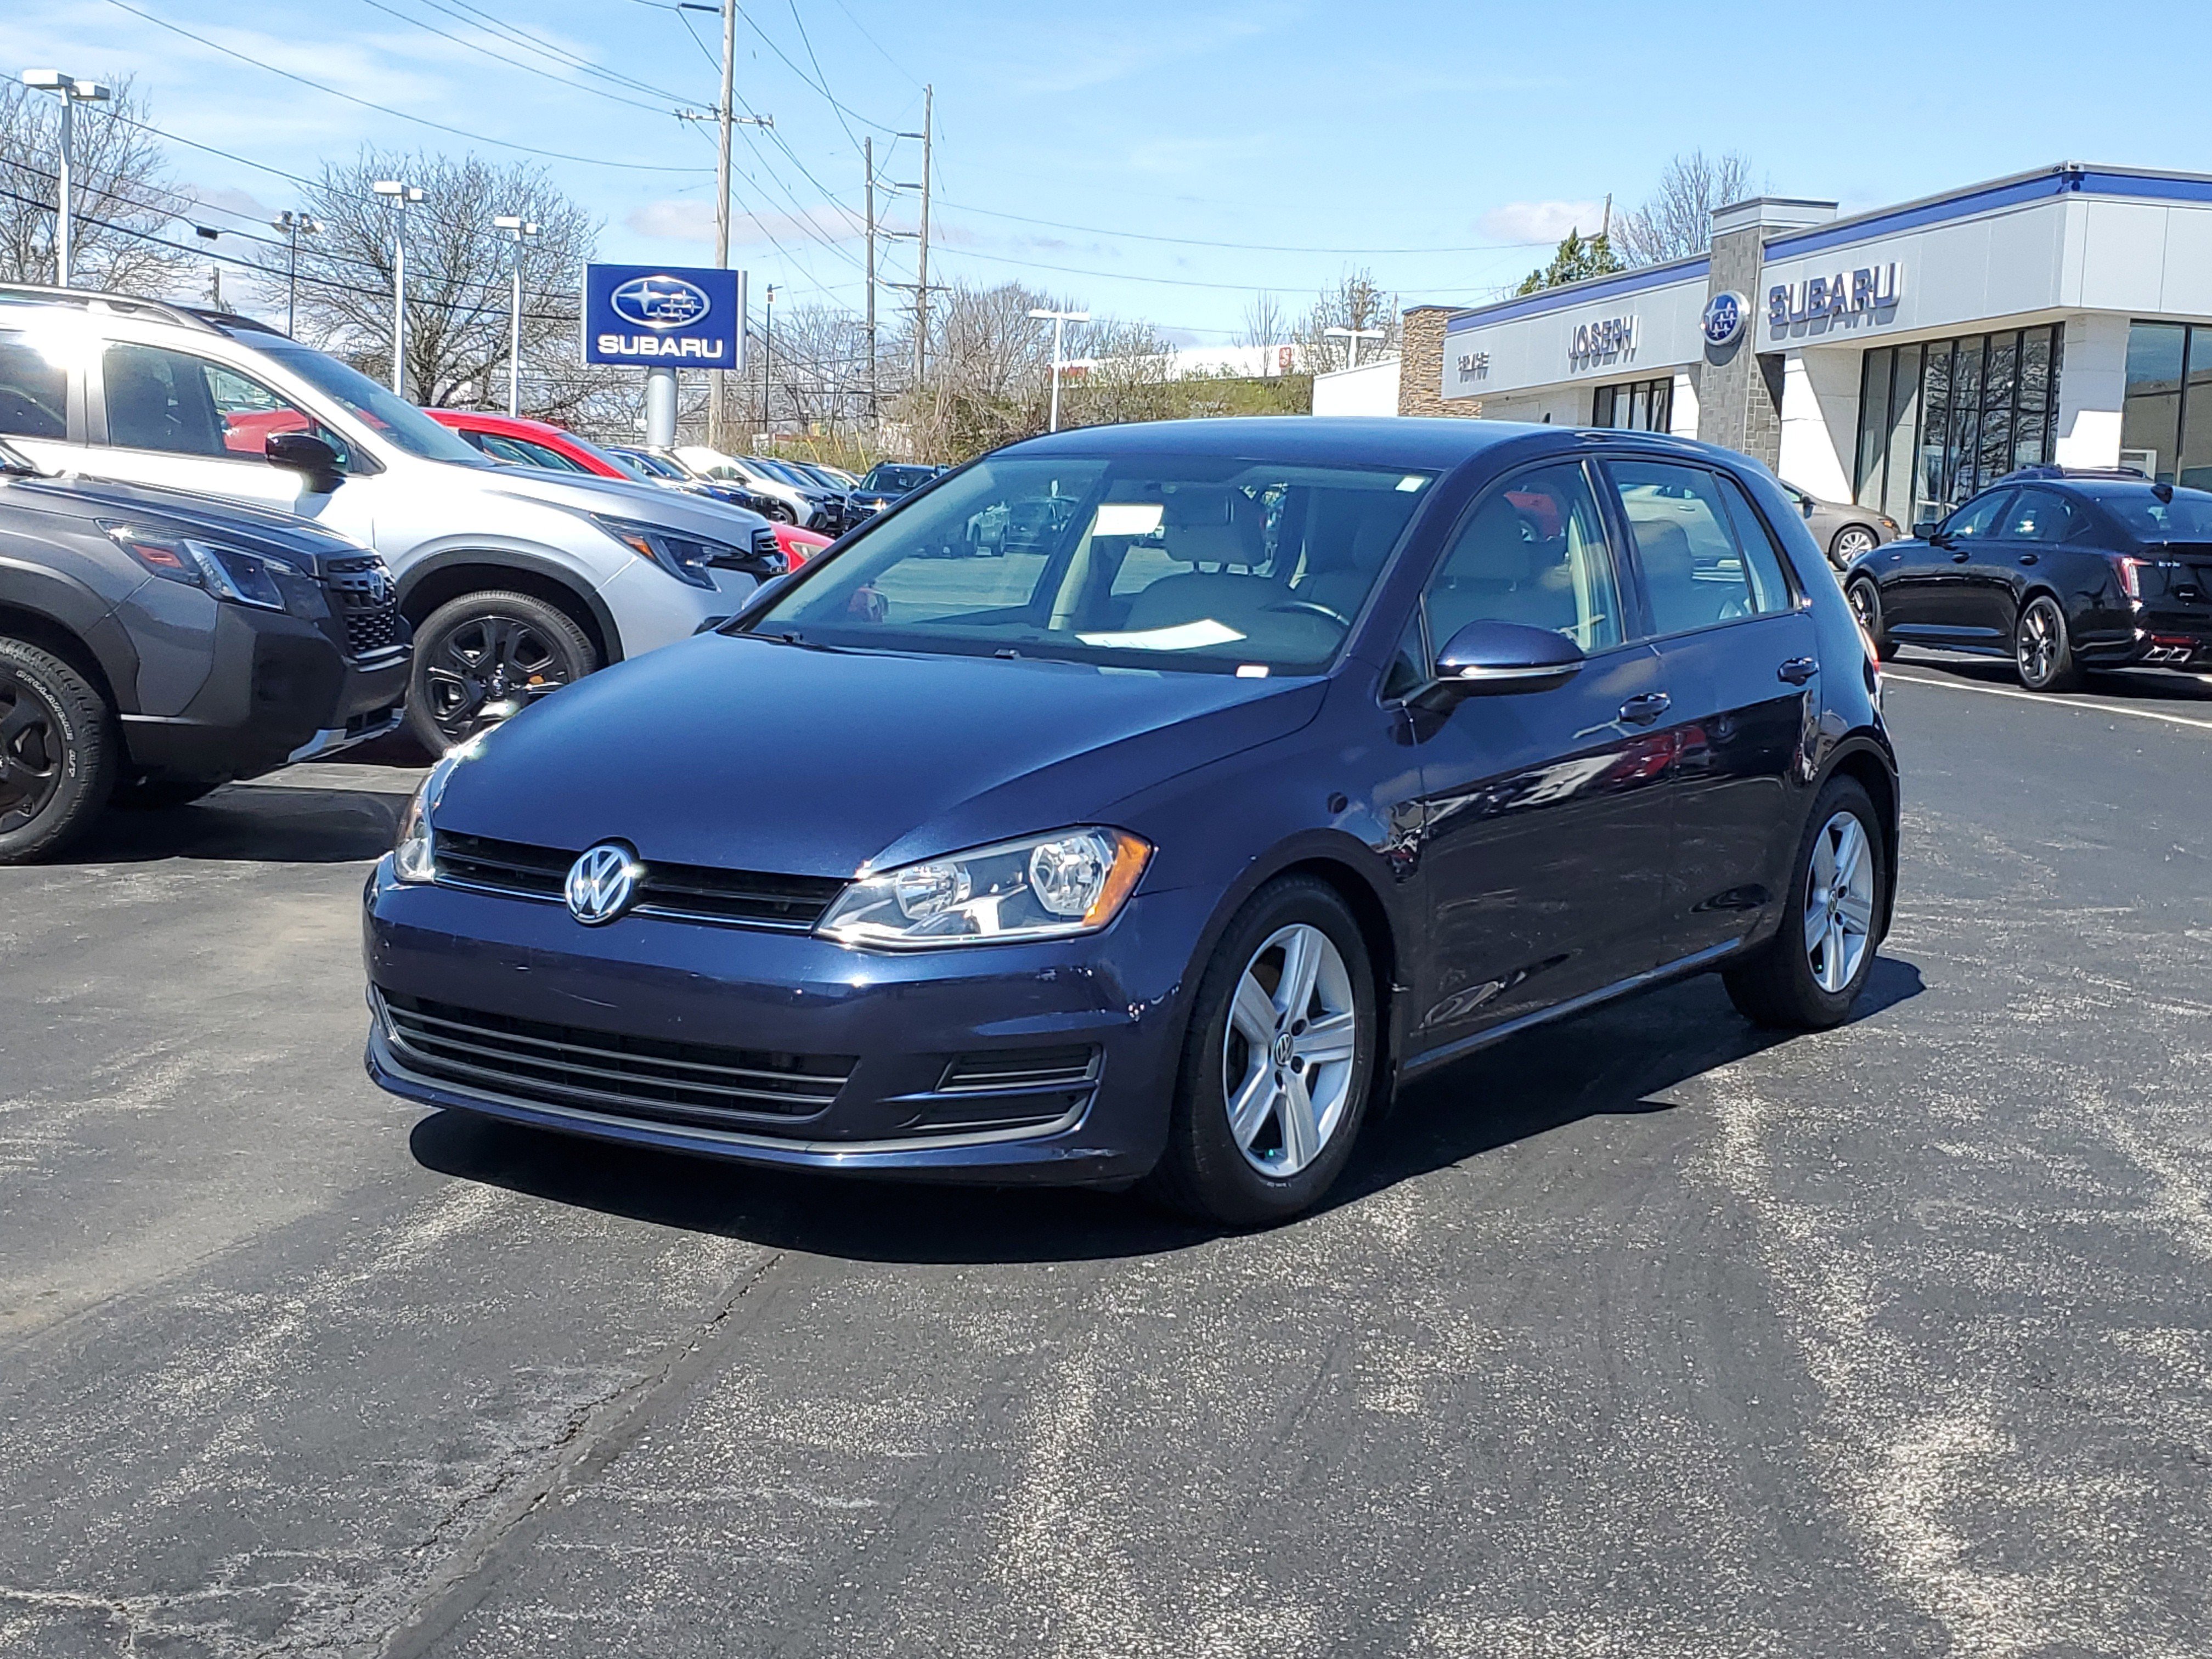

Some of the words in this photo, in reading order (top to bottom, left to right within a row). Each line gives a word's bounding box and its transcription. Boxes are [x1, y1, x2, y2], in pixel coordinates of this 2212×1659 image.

[1568, 315, 1638, 360] JOSEPH
[1768, 262, 1903, 326] SUBARU
[597, 334, 723, 359] SUBARU
